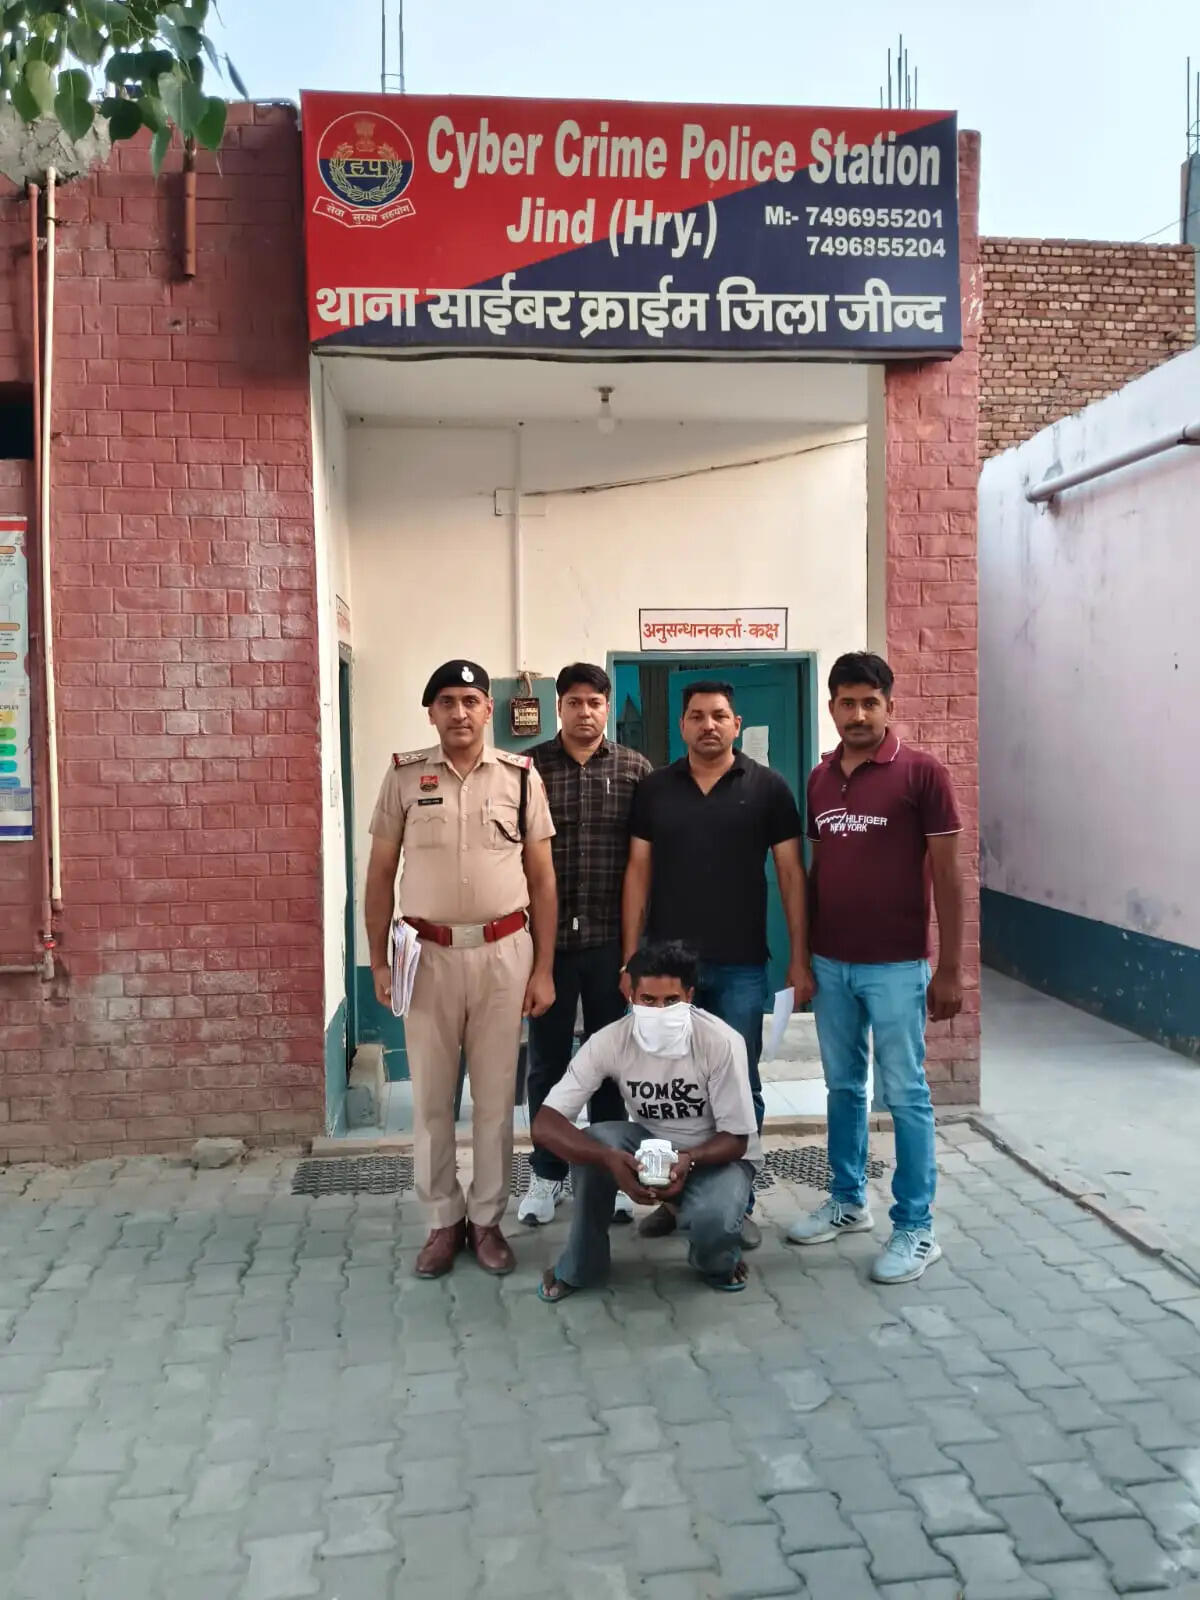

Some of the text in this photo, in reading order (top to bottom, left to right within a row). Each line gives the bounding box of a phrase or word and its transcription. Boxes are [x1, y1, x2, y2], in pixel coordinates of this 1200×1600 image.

[428, 115, 941, 189] Cyber Crime Police Station
[506, 197, 718, 259] Jind (Hry.)
[765, 206, 943, 228] M:- 7496955201
[316, 272, 947, 339] थाना साईबर क्राईम जिला जीन्द
[845, 814, 888, 826] HILFIGER
[847, 823, 868, 833] YORK
[637, 1101, 706, 1119] JERRY
